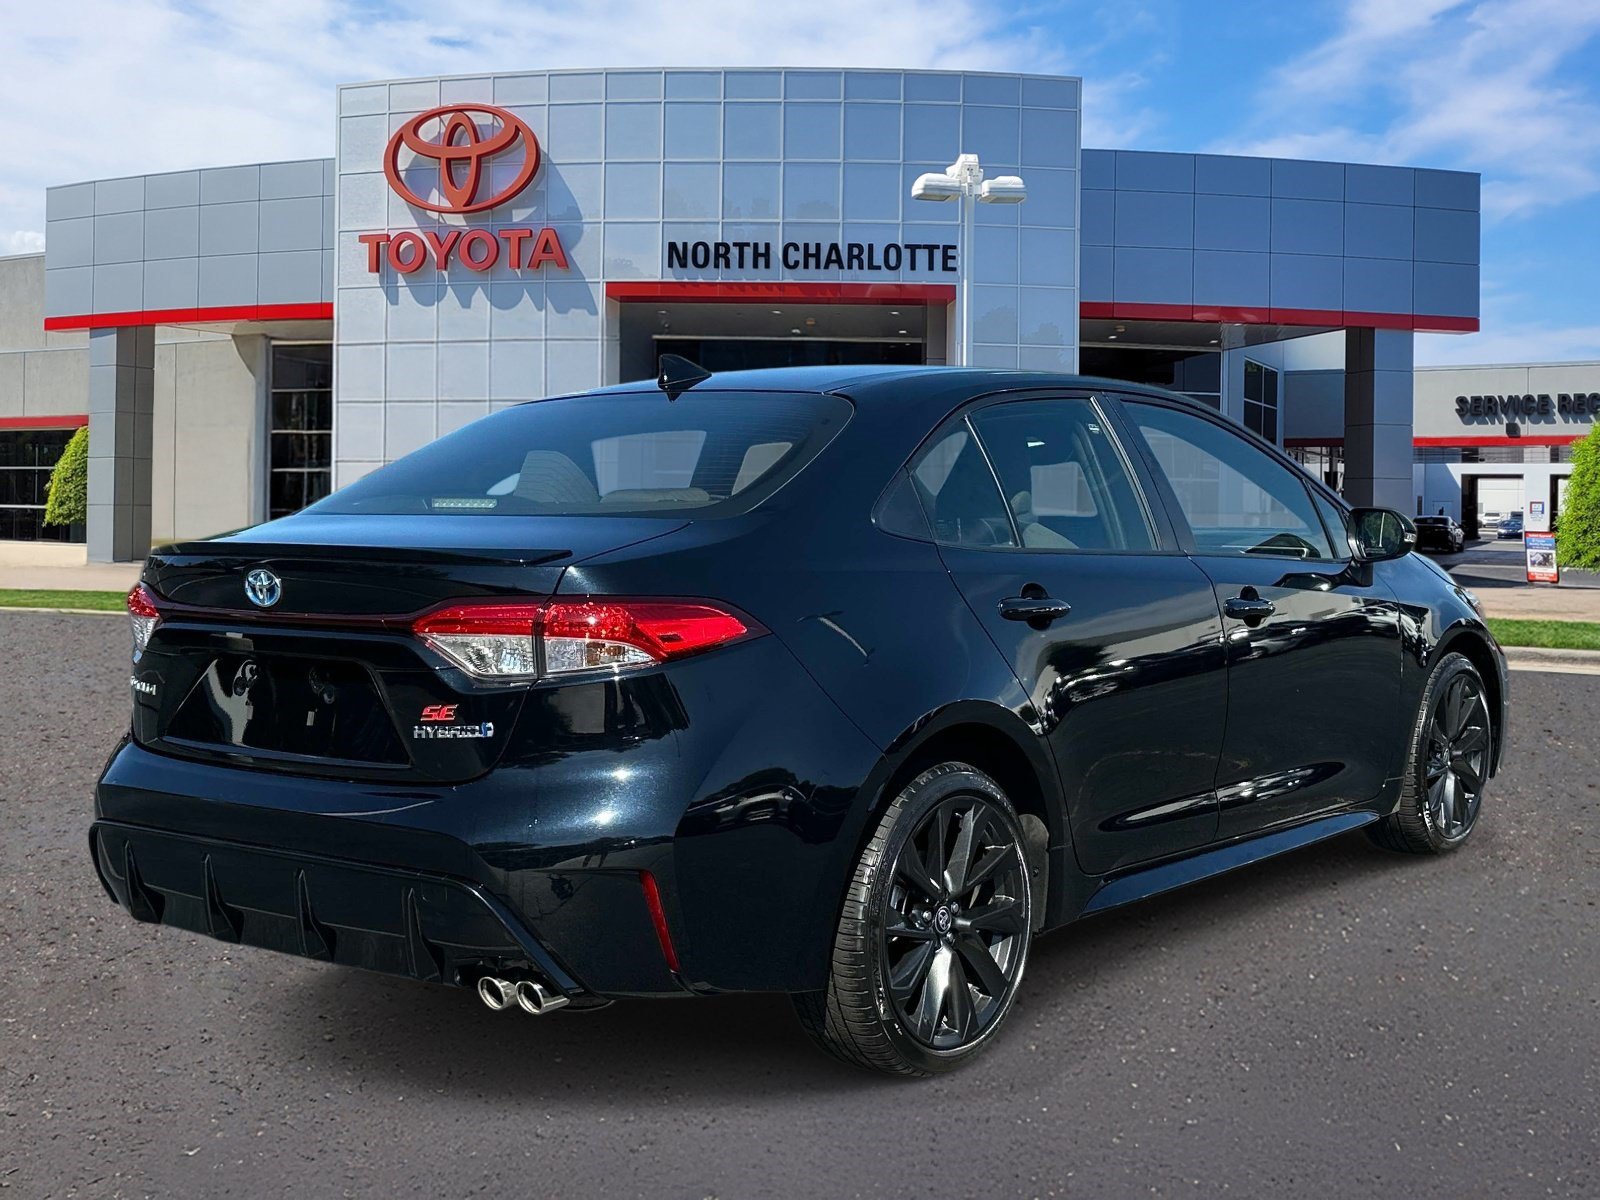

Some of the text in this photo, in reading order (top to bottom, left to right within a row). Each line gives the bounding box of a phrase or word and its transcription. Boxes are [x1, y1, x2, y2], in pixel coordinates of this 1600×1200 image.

[358, 227, 569, 274] TOYOTA
[667, 241, 958, 272] NORTH CHARLOTTE
[1455, 392, 1600, 416] SERVICE REC
[420, 704, 459, 721] SE
[413, 725, 480, 739] HYBRID
